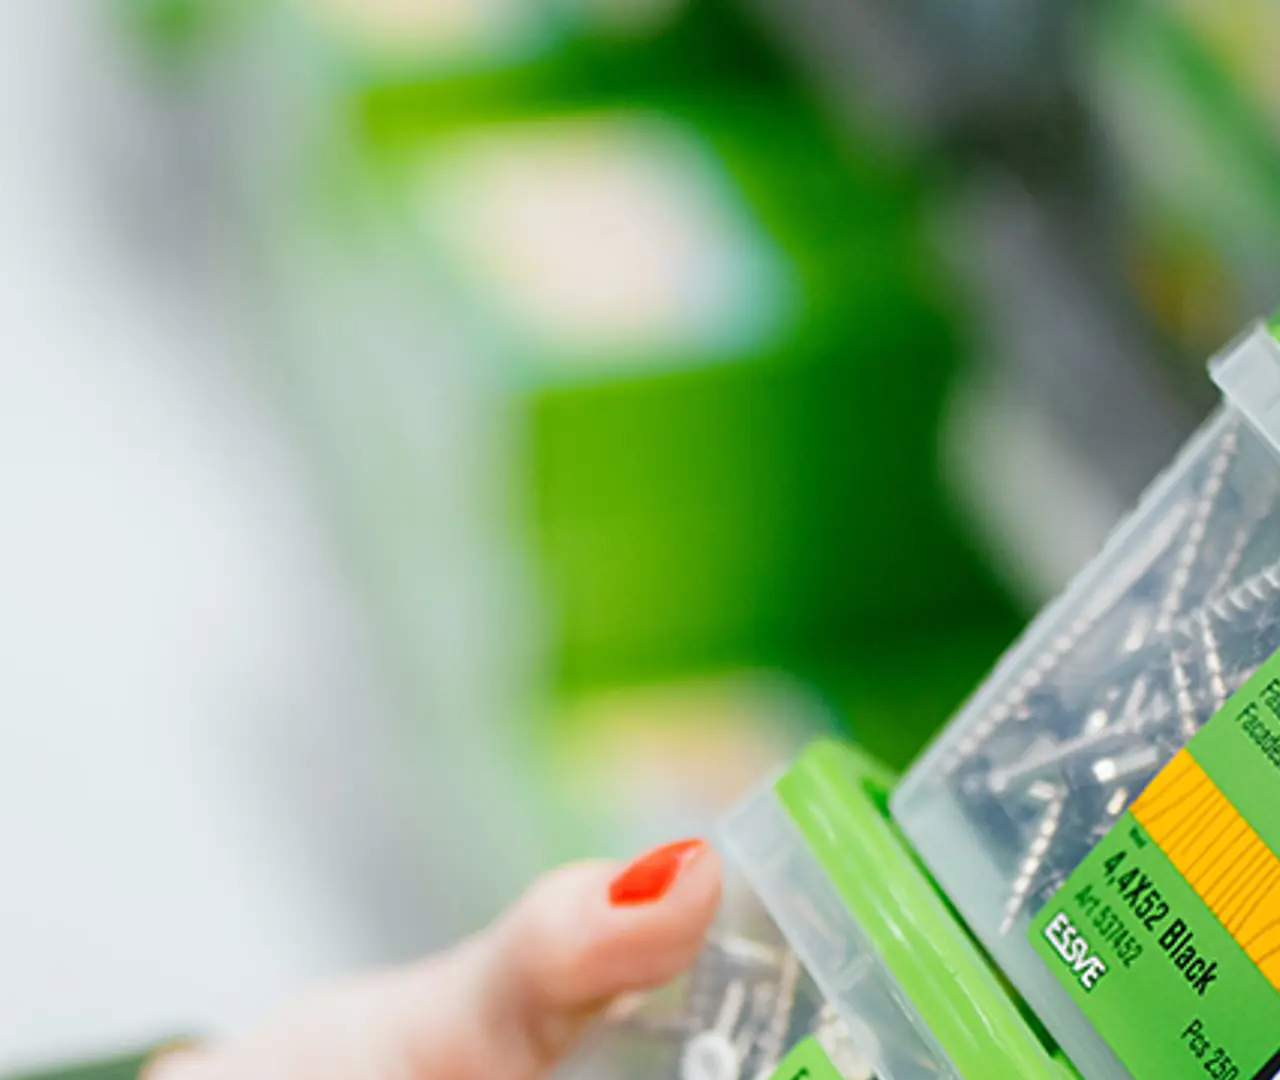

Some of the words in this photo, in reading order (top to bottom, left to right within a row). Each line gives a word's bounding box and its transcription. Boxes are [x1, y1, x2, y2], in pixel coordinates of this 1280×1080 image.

[1074, 884, 1101, 917] Art
[1104, 851, 1170, 932] 4,4X52
[1158, 918, 1218, 996] Black
[1045, 913, 1105, 988] ESSVE
[1181, 1019, 1211, 1059] Pcs
